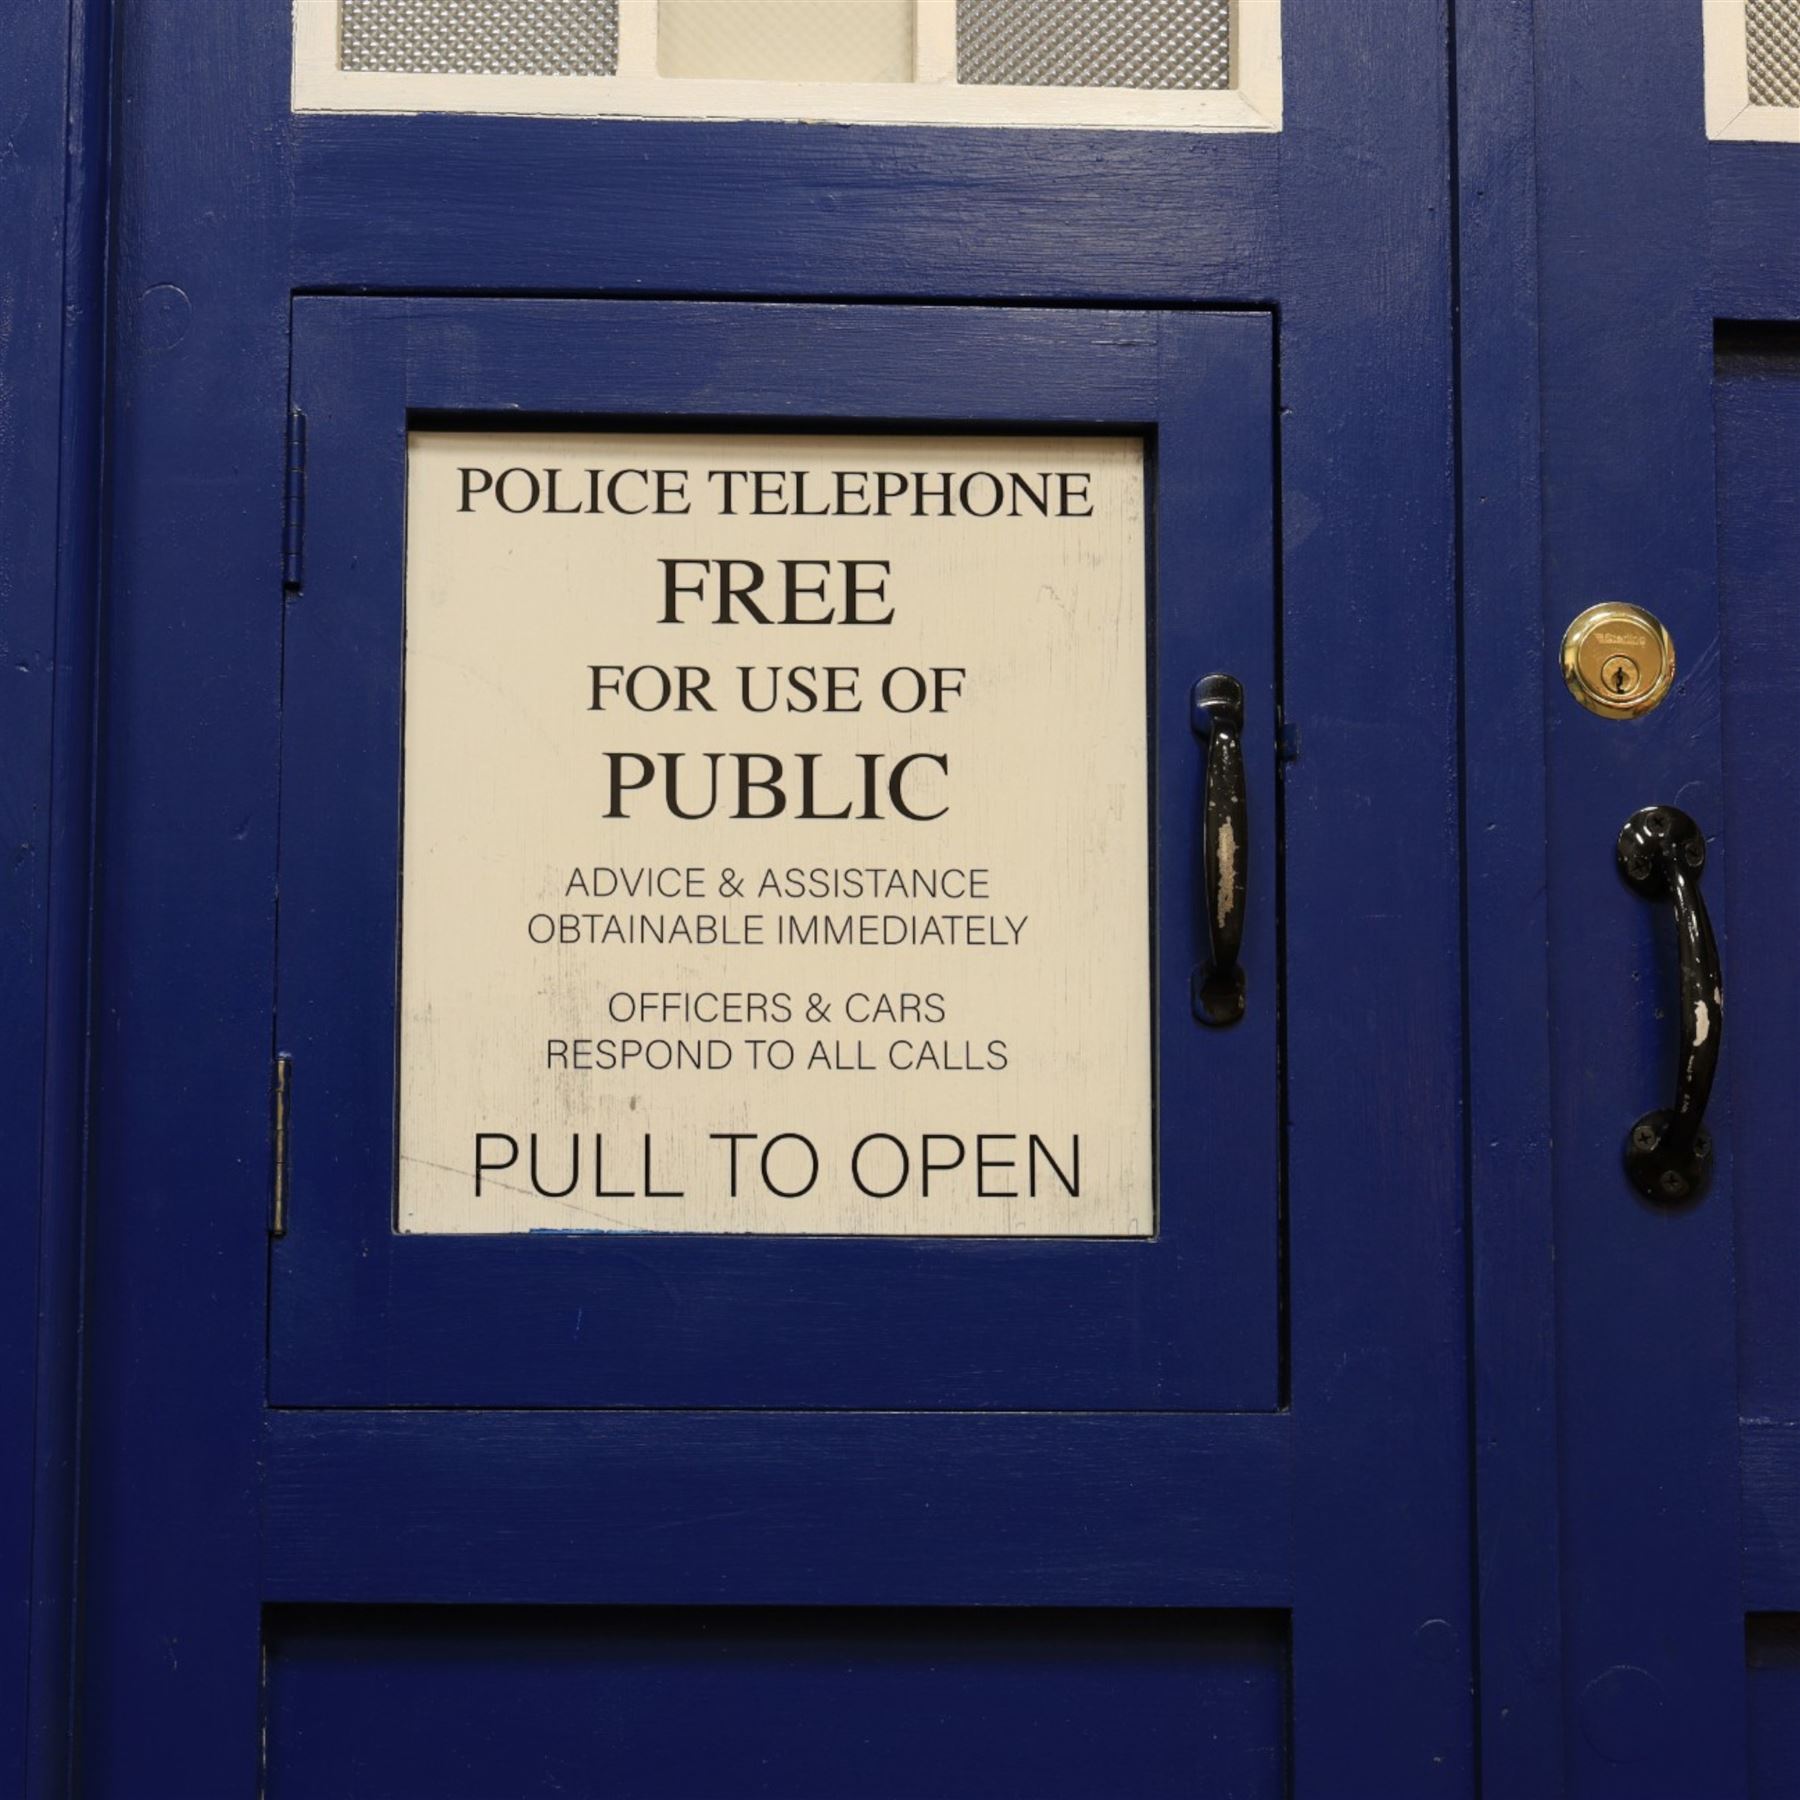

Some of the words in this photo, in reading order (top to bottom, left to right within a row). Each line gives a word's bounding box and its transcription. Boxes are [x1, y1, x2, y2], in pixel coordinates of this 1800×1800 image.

[458, 467, 691, 515] POLICE
[708, 470, 1094, 518] TELEPHONE
[657, 558, 895, 625] FREE
[588, 665, 717, 712] FOR
[736, 666, 862, 713] USE
[881, 666, 966, 714] OF
[602, 752, 949, 822] PUBLIC
[565, 867, 705, 898] ADVICE
[718, 867, 744, 898] &
[758, 867, 989, 899] ASSISTANCE
[528, 913, 764, 945] OBTAINABLE
[779, 915, 1028, 945] IMMEDIATELY
[608, 992, 792, 1023] OFFICERS
[805, 992, 831, 1023] &
[845, 992, 945, 1023] CARS
[547, 1039, 732, 1070] RESPOND
[744, 1039, 794, 1070] TO
[807, 1040, 876, 1070] ALL
[889, 1039, 1008, 1070] CALLS
[475, 1132, 685, 1198] PULL
[709, 1132, 819, 1199] TO
[851, 1132, 1080, 1199] OPEN
